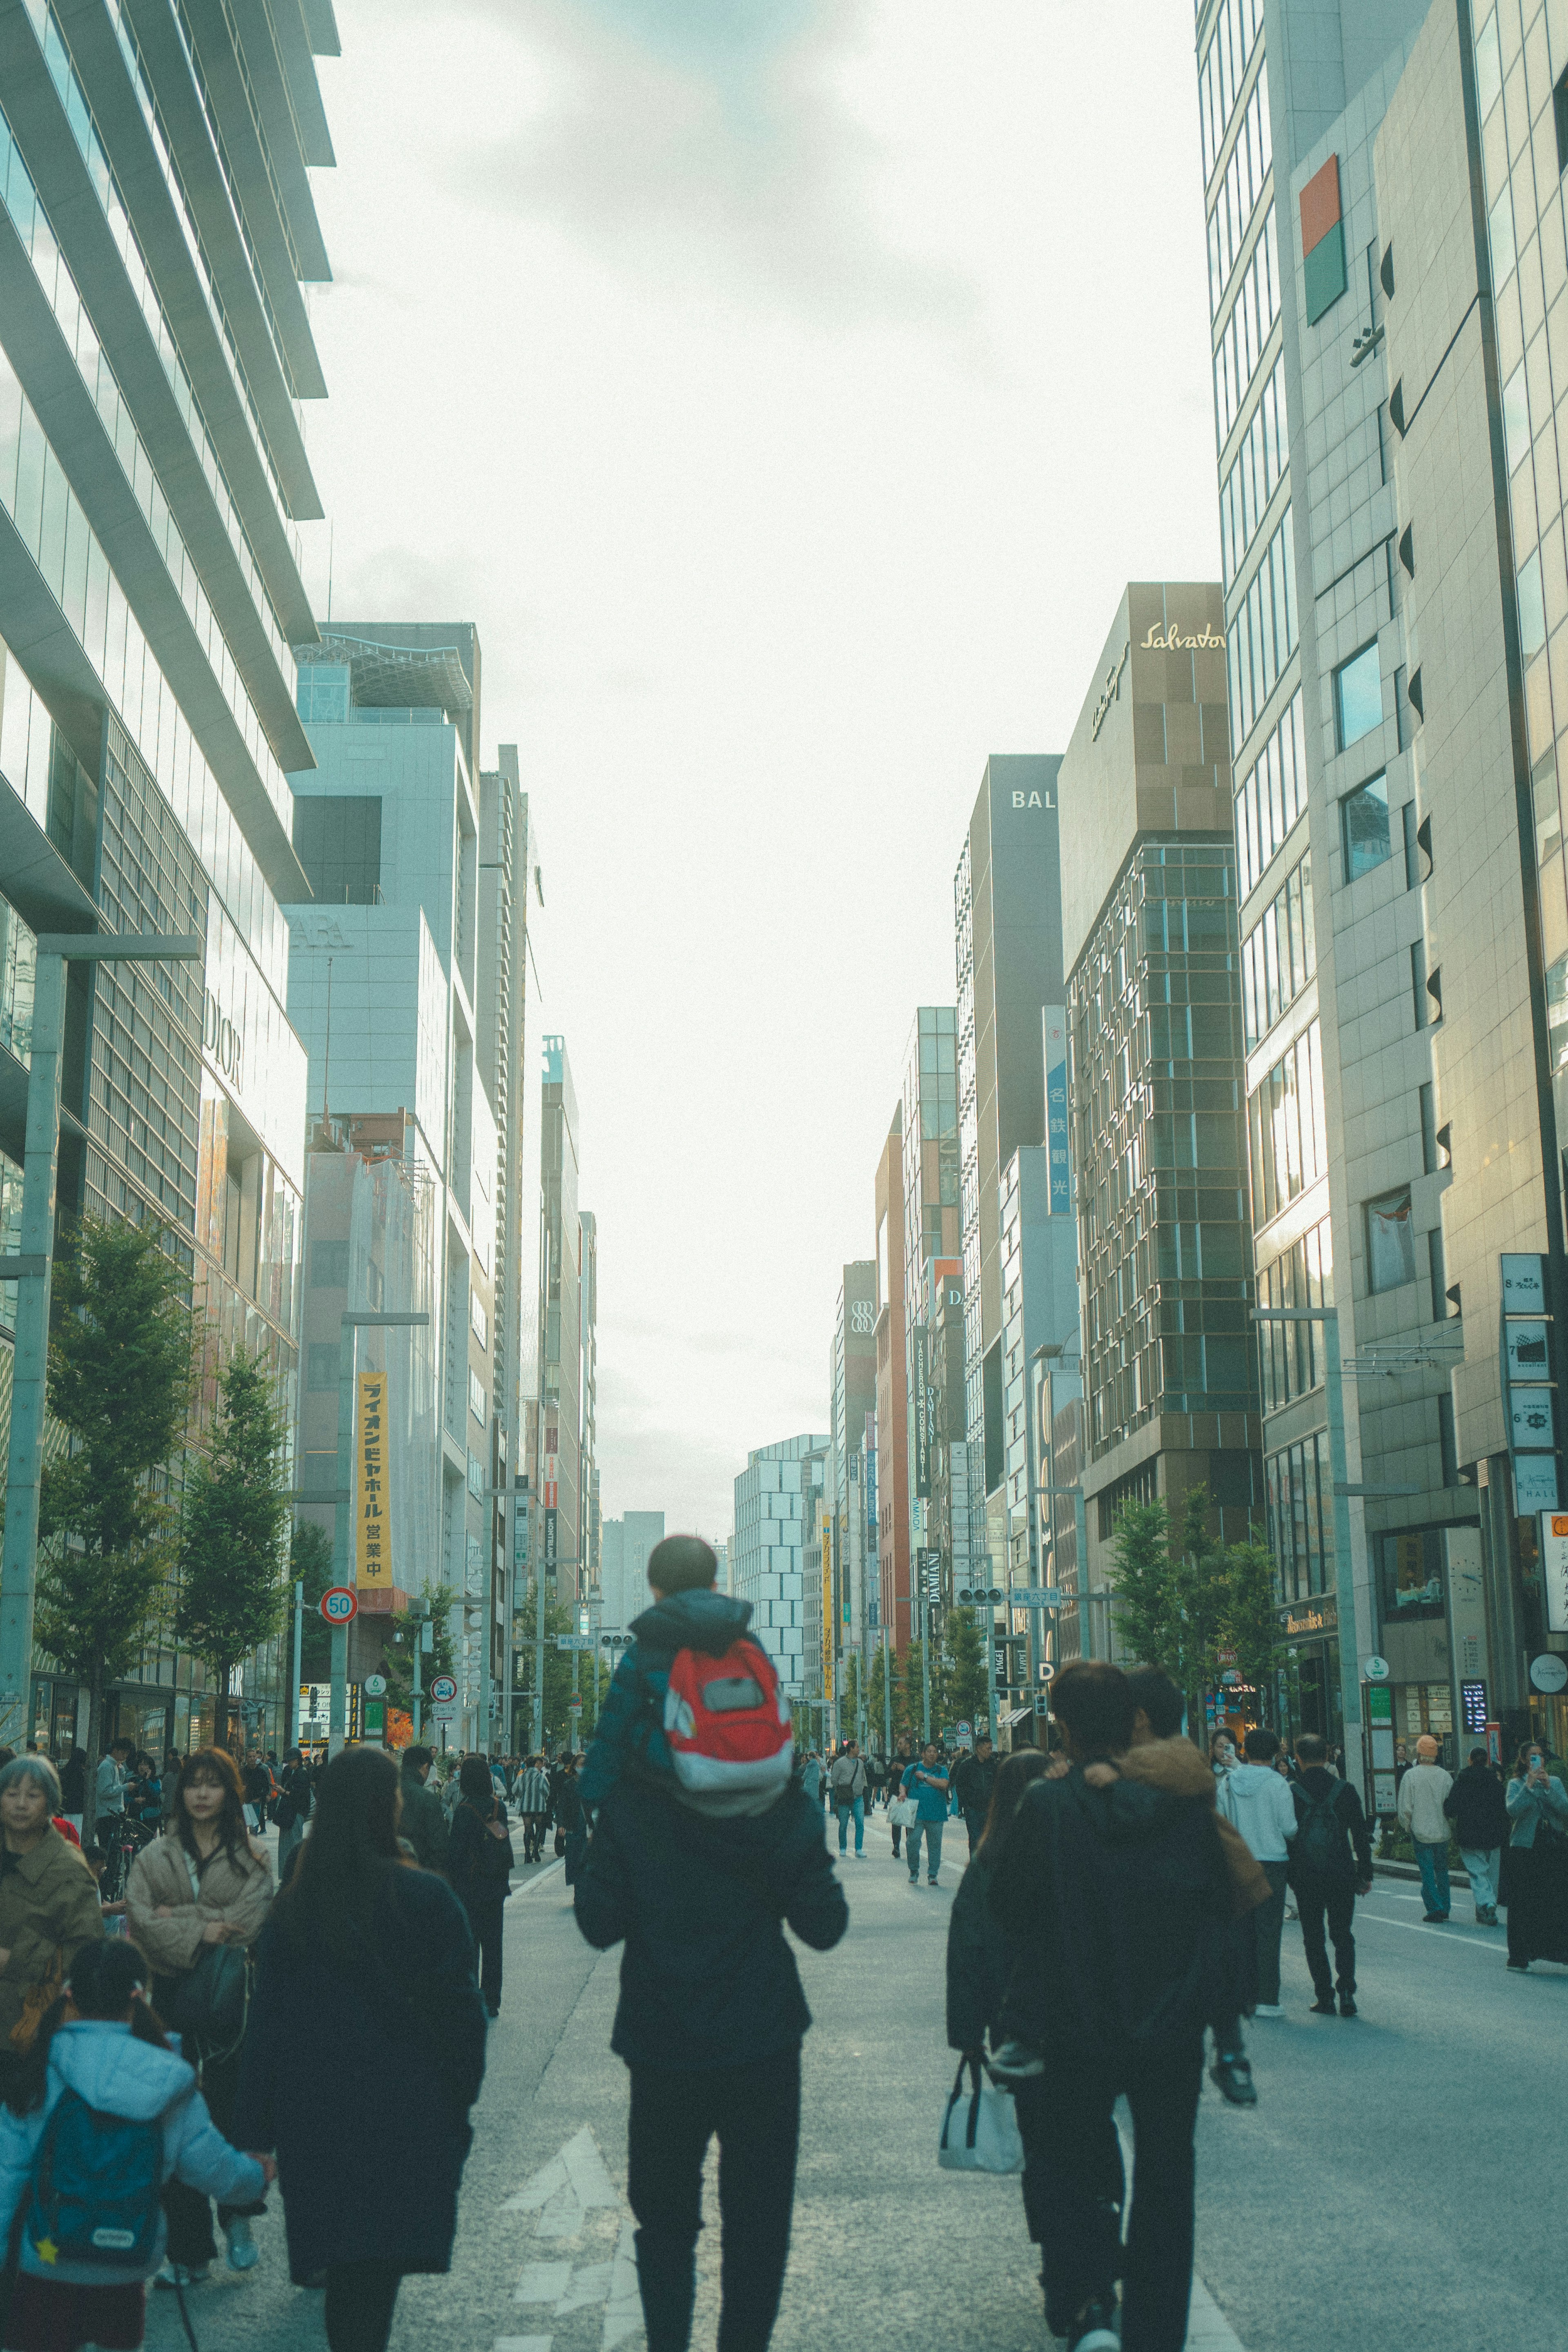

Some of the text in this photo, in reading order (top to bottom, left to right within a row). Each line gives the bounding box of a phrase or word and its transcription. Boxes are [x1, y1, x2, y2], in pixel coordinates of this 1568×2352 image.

[203, 987, 241, 1095] DIOR
[1049, 1087, 1068, 1195] 名鉄観光
[1506, 1279, 1512, 1288] 8
[1510, 1346, 1515, 1355] 7
[1514, 1413, 1521, 1423] 6
[364, 1383, 382, 1577] ライオンビヤホール 営業中
[929, 1553, 940, 1603] DAMIANI
[1014, 1593, 1058, 1601] 銀座六丁目
[329, 1598, 350, 1613] 50
[1374, 1660, 1379, 1668] 5
[1039, 1663, 1055, 1681] D
[372, 1677, 379, 1687] 6
